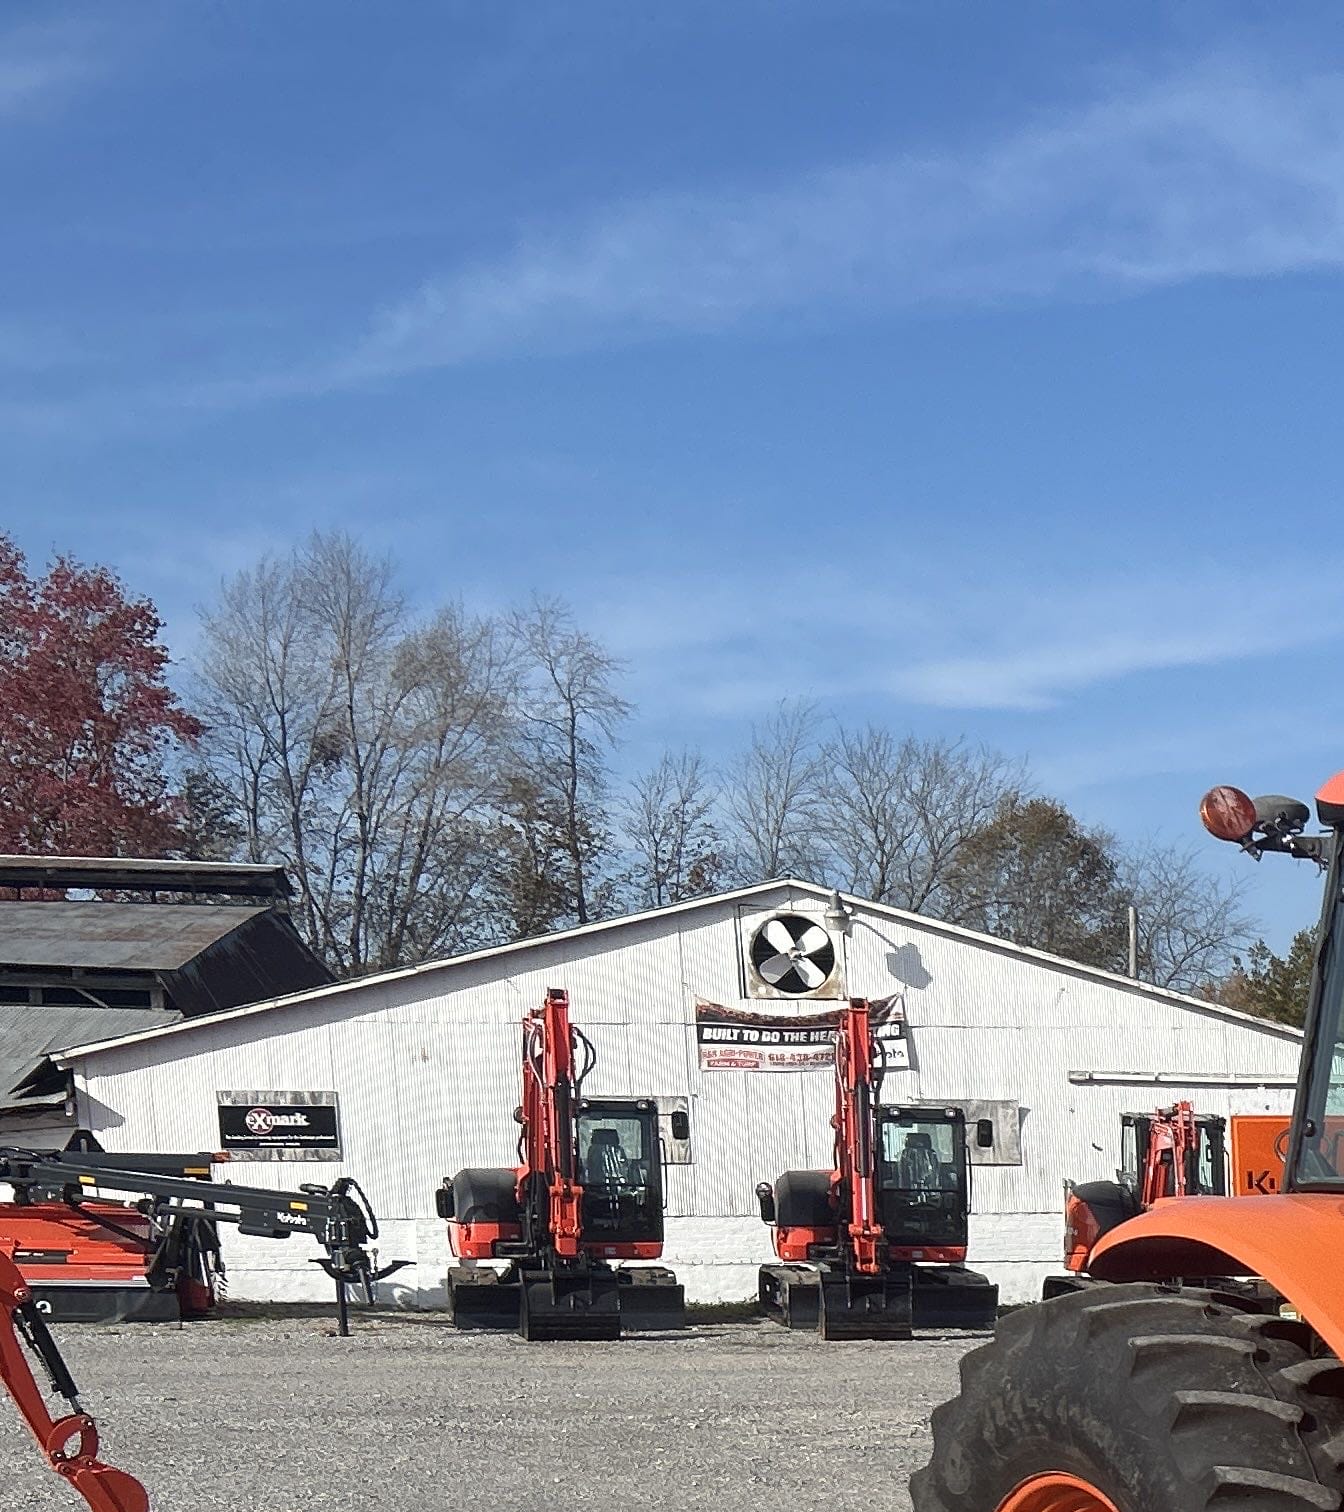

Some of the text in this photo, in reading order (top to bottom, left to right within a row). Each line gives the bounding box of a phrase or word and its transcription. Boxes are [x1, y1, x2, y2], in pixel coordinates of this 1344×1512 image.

[703, 1027, 839, 1043] BUILT TO DO THE HEA
